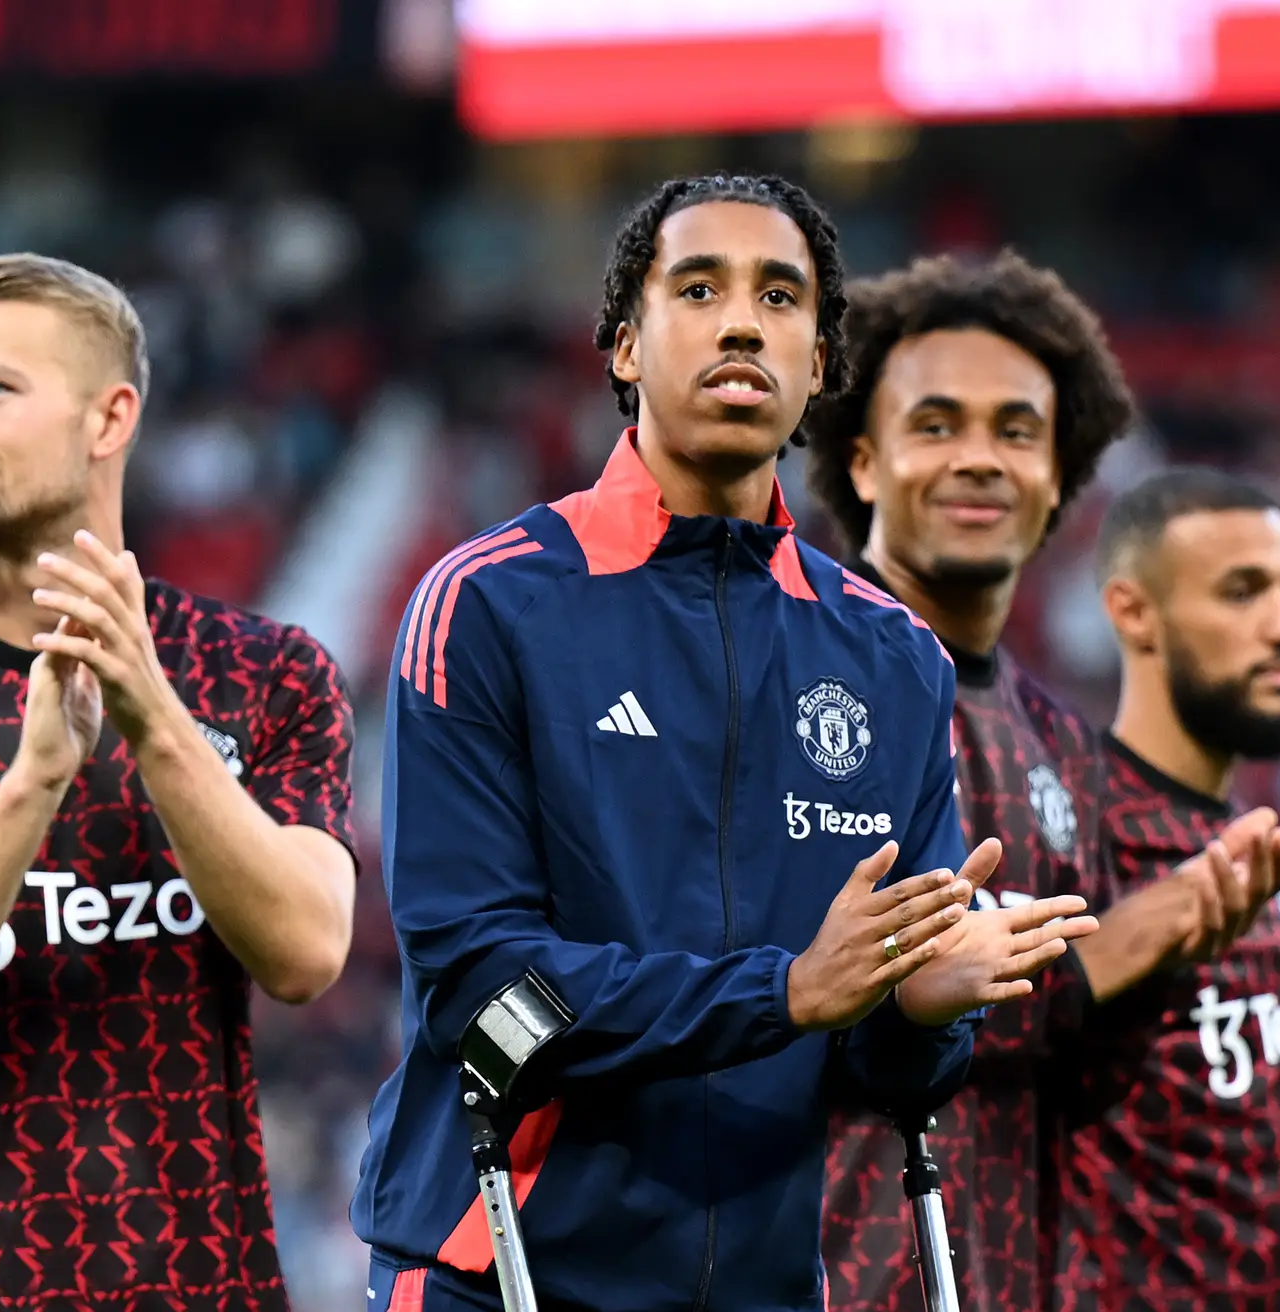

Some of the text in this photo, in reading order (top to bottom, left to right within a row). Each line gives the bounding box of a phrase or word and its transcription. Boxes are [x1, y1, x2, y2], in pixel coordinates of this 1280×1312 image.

[803, 689, 863, 723] MANCHESTER
[815, 750, 857, 769] UNITED
[814, 802, 893, 836] Tezos
[24, 871, 205, 945] Tezo
